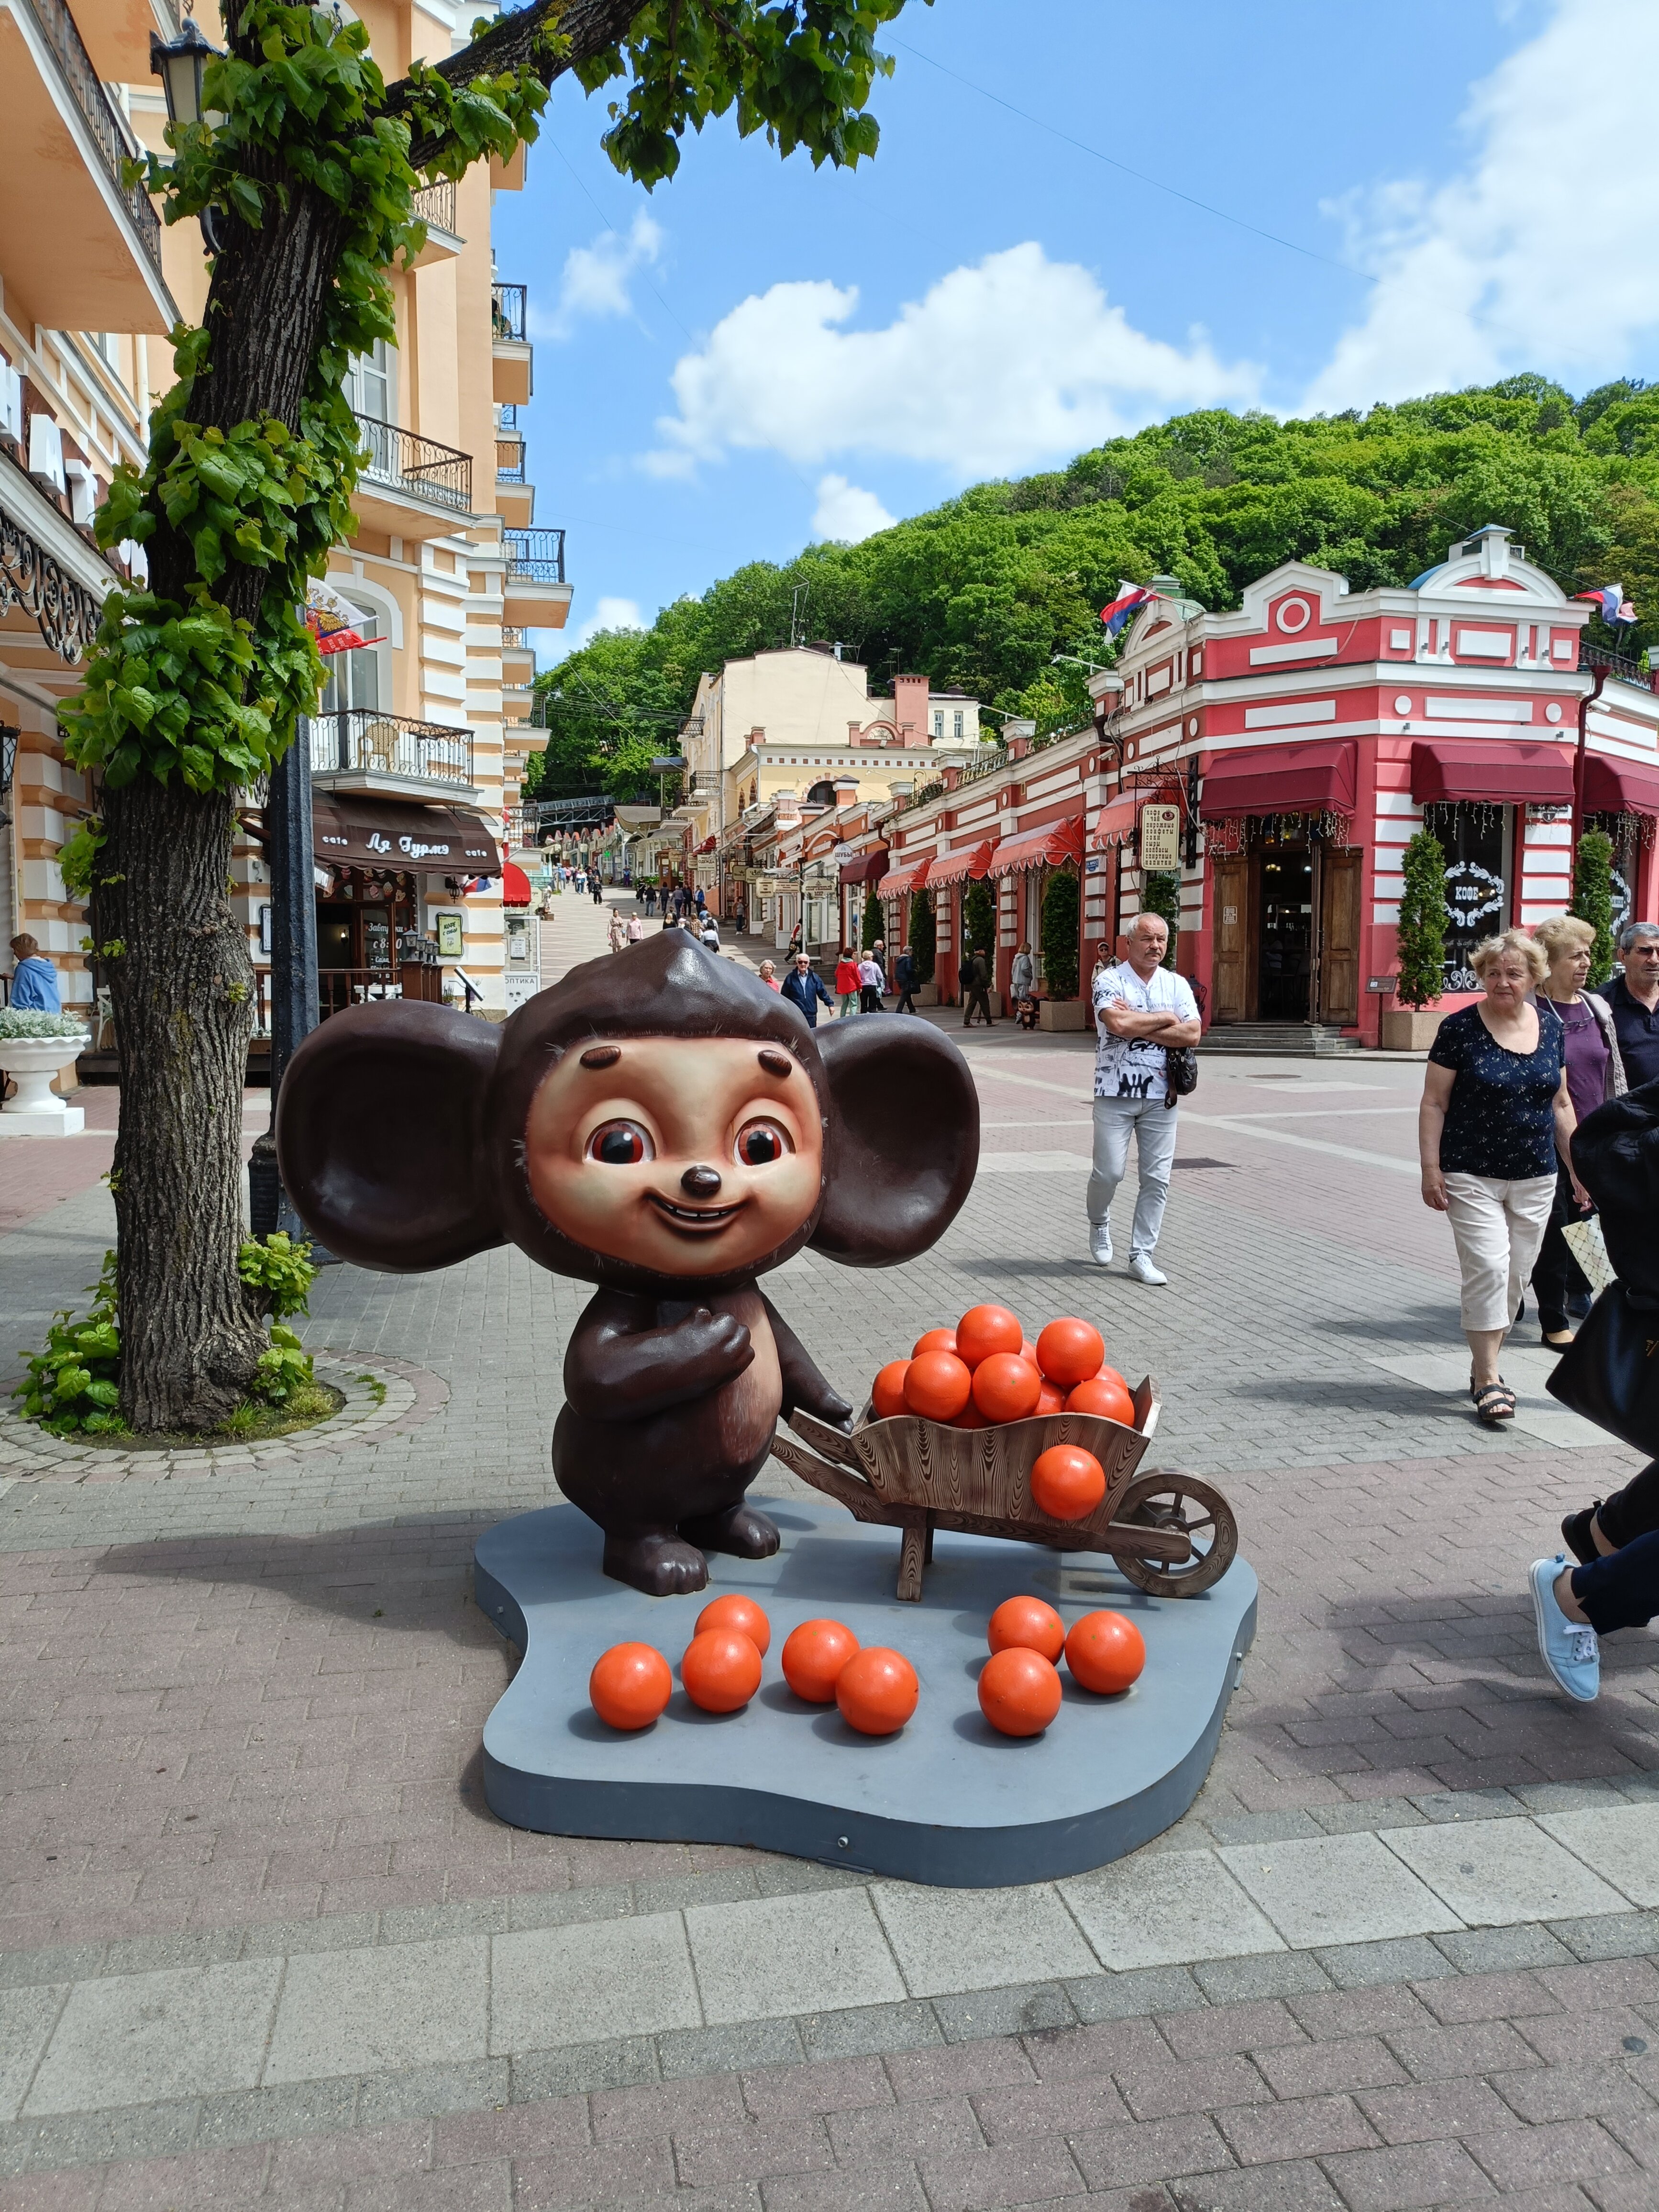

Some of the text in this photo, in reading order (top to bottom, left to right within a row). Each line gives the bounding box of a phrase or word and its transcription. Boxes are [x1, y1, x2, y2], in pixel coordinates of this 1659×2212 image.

[322, 836, 348, 845] cafe
[365, 833, 449, 859] Ля Гурмэ
[465, 849, 487, 857] cafe
[1455, 886, 1478, 901] КОФЕ
[380, 938, 402, 950] 8:0
